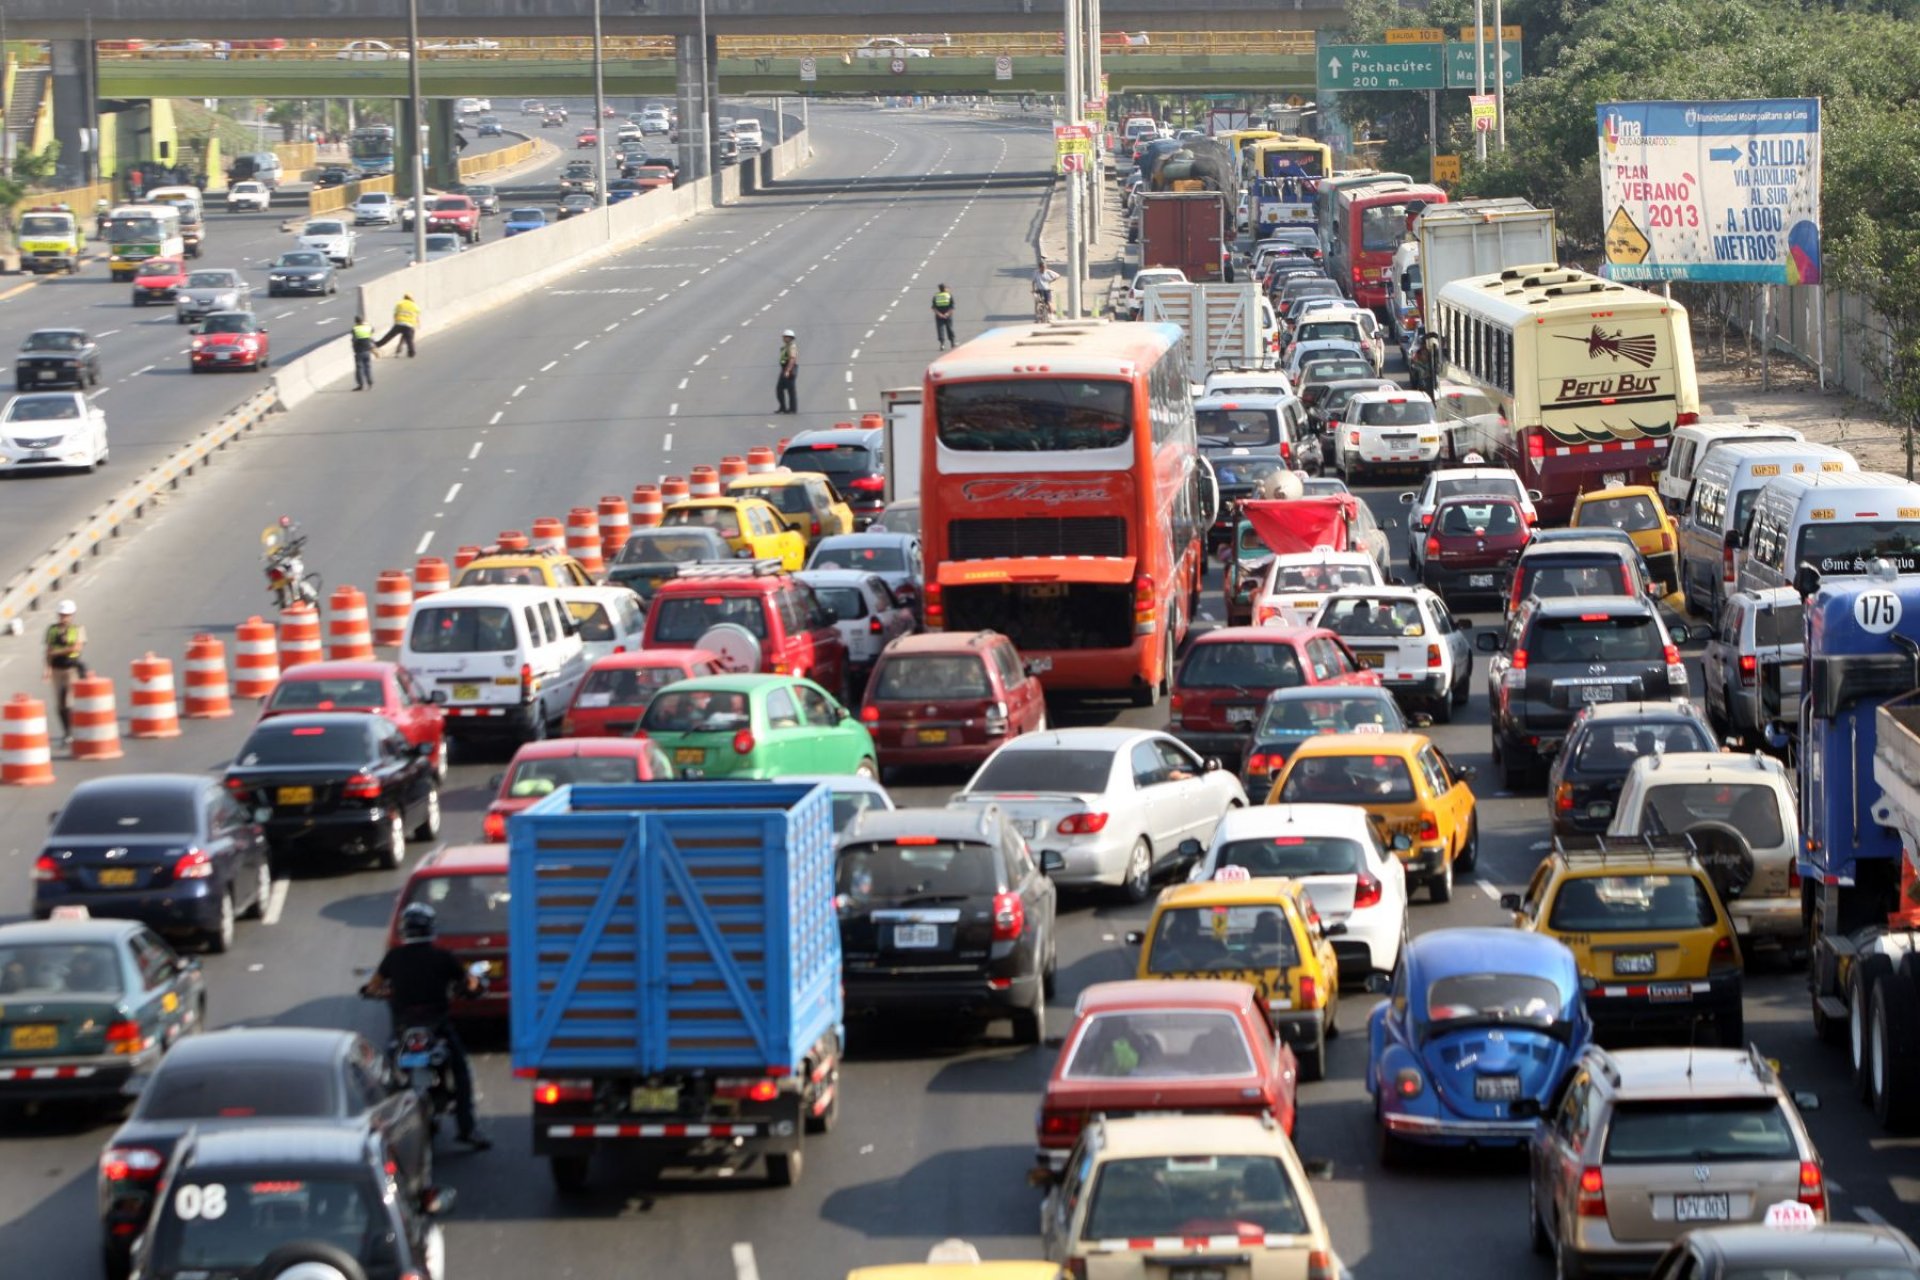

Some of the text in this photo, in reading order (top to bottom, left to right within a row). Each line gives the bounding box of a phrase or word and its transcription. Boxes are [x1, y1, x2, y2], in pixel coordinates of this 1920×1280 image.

[1352, 49, 1371, 59] Av.
[1352, 60, 1433, 74] Pachacútec
[1352, 77, 1404, 87] 200 m.
[1783, 111, 1792, 120] de
[1793, 110, 1808, 119] Lima
[1608, 113, 1641, 136] Lima
[1748, 139, 1806, 167] SALIDA
[1617, 164, 1649, 180] PLAN
[1753, 168, 1797, 186] AUXILIAR
[1622, 182, 1689, 201] VERANO
[1750, 187, 1789, 205] AL SUR
[1648, 204, 1699, 227] 2013
[1727, 207, 1782, 232] A 1000
[1713, 234, 1777, 261] METROS
[1653, 267, 1666, 280] DE
[1666, 267, 1689, 280] LIMA
[1617, 373, 1661, 394] Bus
[1860, 595, 1894, 625] 175
[174, 1183, 228, 1221] 08
[1773, 1208, 1808, 1220] TAXI
